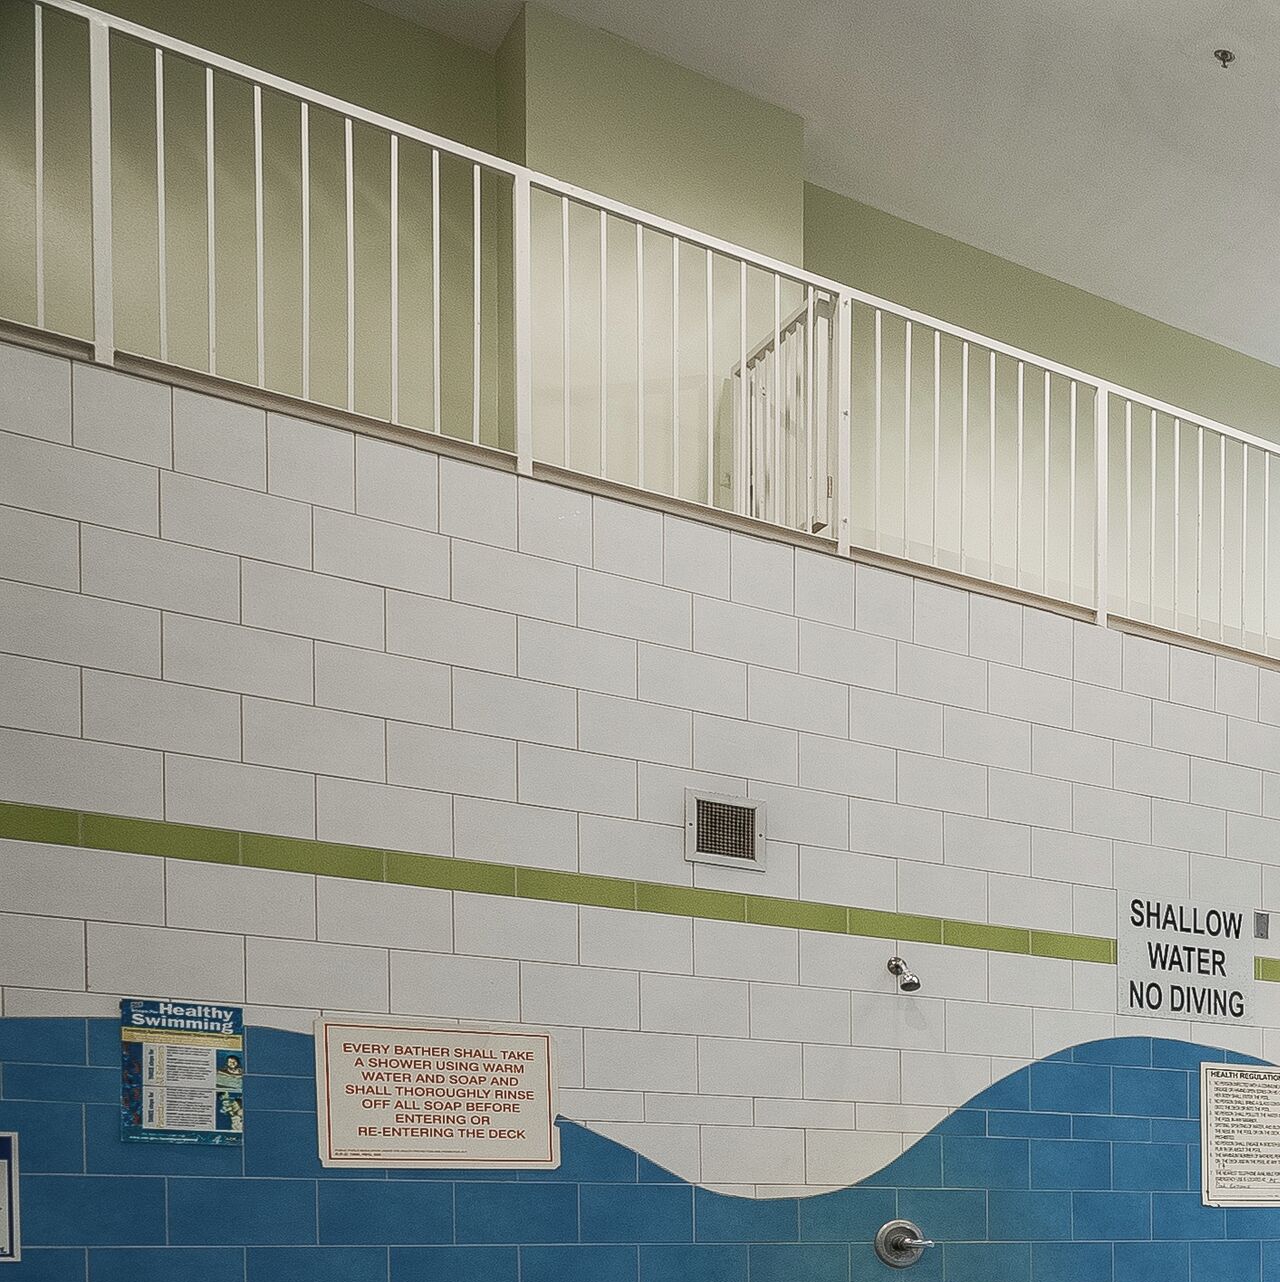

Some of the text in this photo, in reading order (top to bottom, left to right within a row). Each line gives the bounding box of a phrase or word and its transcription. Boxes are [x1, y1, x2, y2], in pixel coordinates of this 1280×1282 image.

[1130, 898, 1243, 940] SHALLOW
[1147, 941, 1227, 978] WATER
[1129, 980, 1244, 1018] NO DIVING
[159, 1002, 234, 1022] Healthy
[131, 1013, 234, 1035] Swimming
[343, 1042, 534, 1061] EVERY BATHER SHALL TAKE
[354, 1057, 525, 1074] A SHOWER USING WARM
[361, 1071, 519, 1087] WATER AND SOAP AND
[1211, 1071, 1239, 1079] HEALTH
[345, 1084, 534, 1100] SHALL THOROUGHLY RINSE
[361, 1098, 521, 1113] OFF ALL SOAP BEFORE
[395, 1113, 490, 1125] ENTERING OR
[357, 1126, 526, 1140] RE-ENTERING THE DECK
